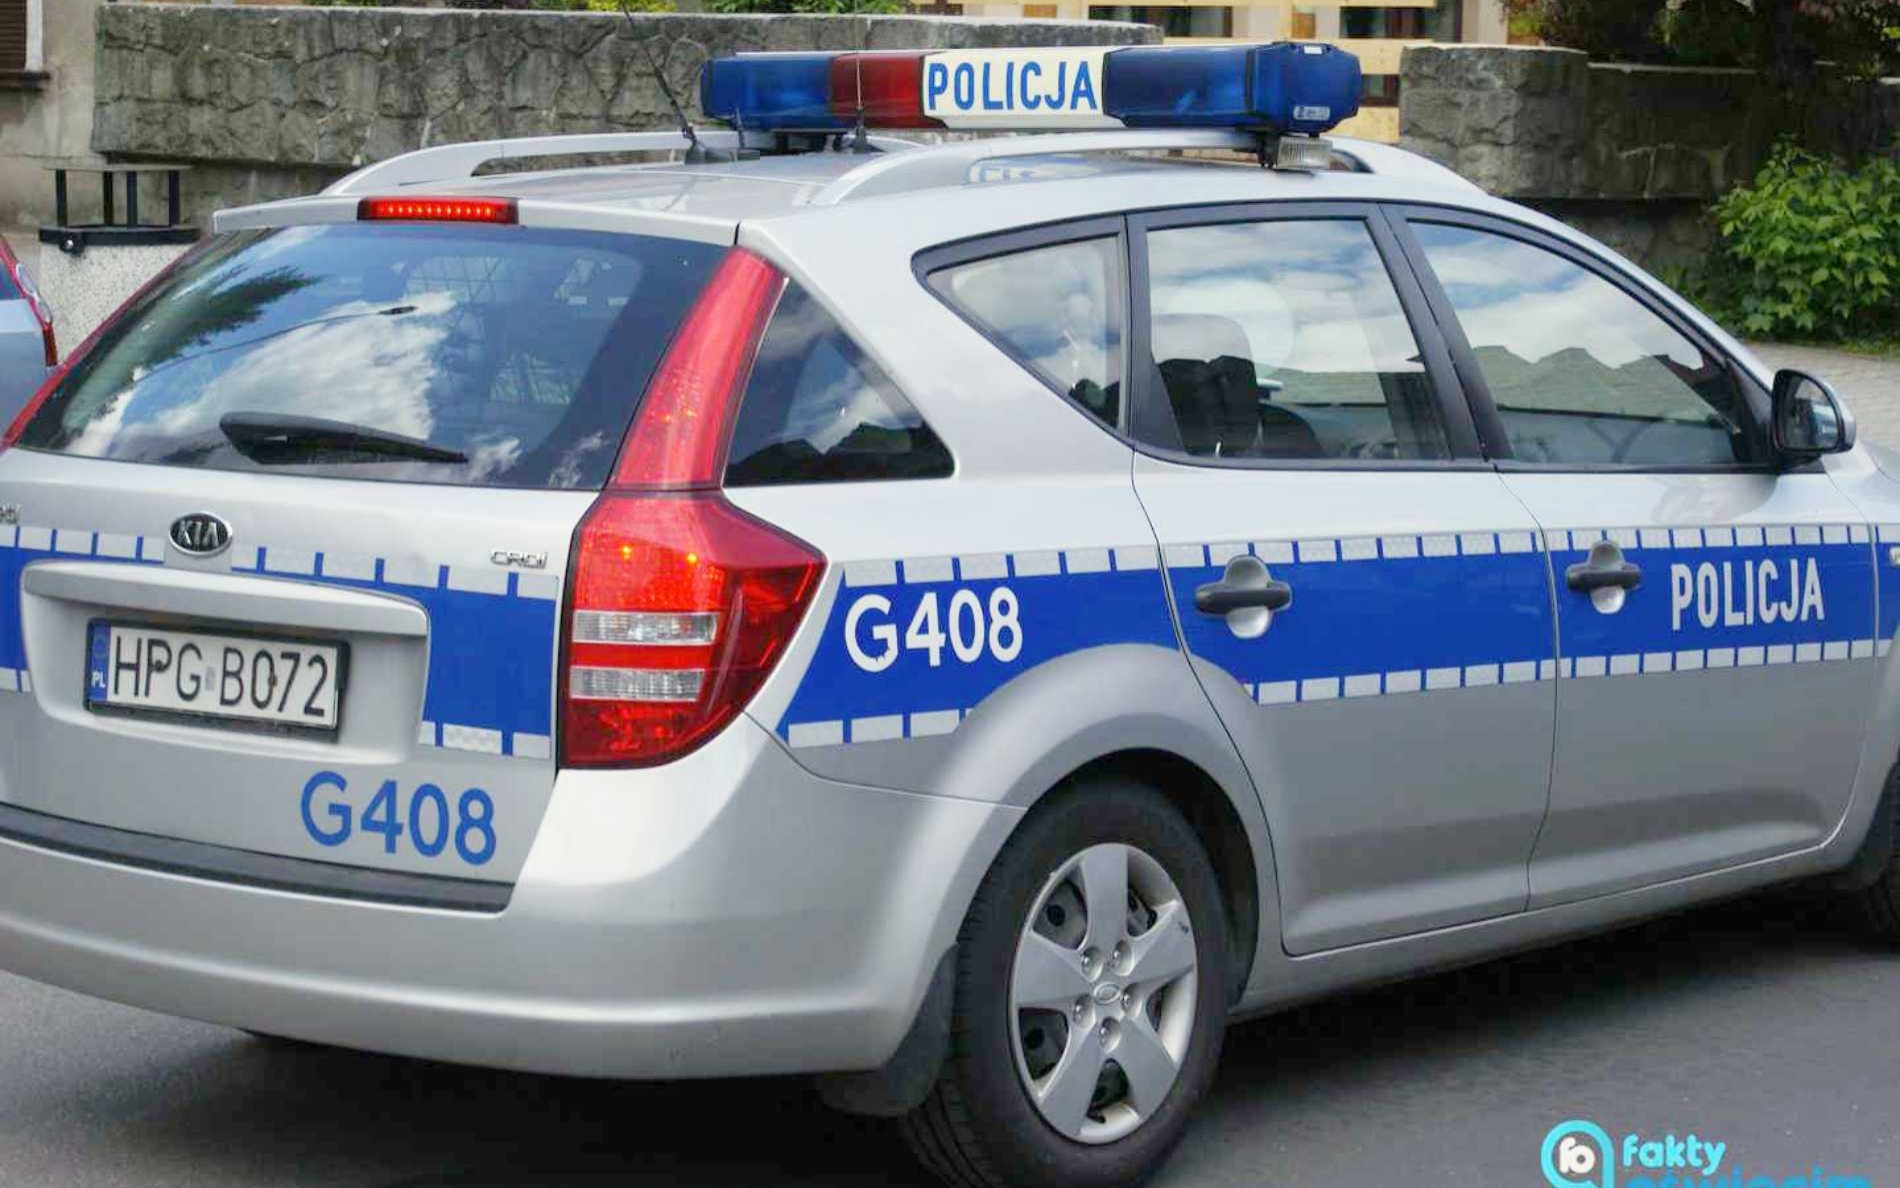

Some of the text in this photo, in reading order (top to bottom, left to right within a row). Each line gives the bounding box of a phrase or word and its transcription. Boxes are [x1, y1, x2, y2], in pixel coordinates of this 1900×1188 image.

[928, 60, 1099, 112] POLICJA
[177, 519, 220, 548] KIA
[845, 587, 1023, 673] G408
[1671, 557, 1825, 631] POLICJA
[91, 671, 106, 688] PL
[114, 635, 328, 717] HPG B072
[301, 770, 497, 866] G408
